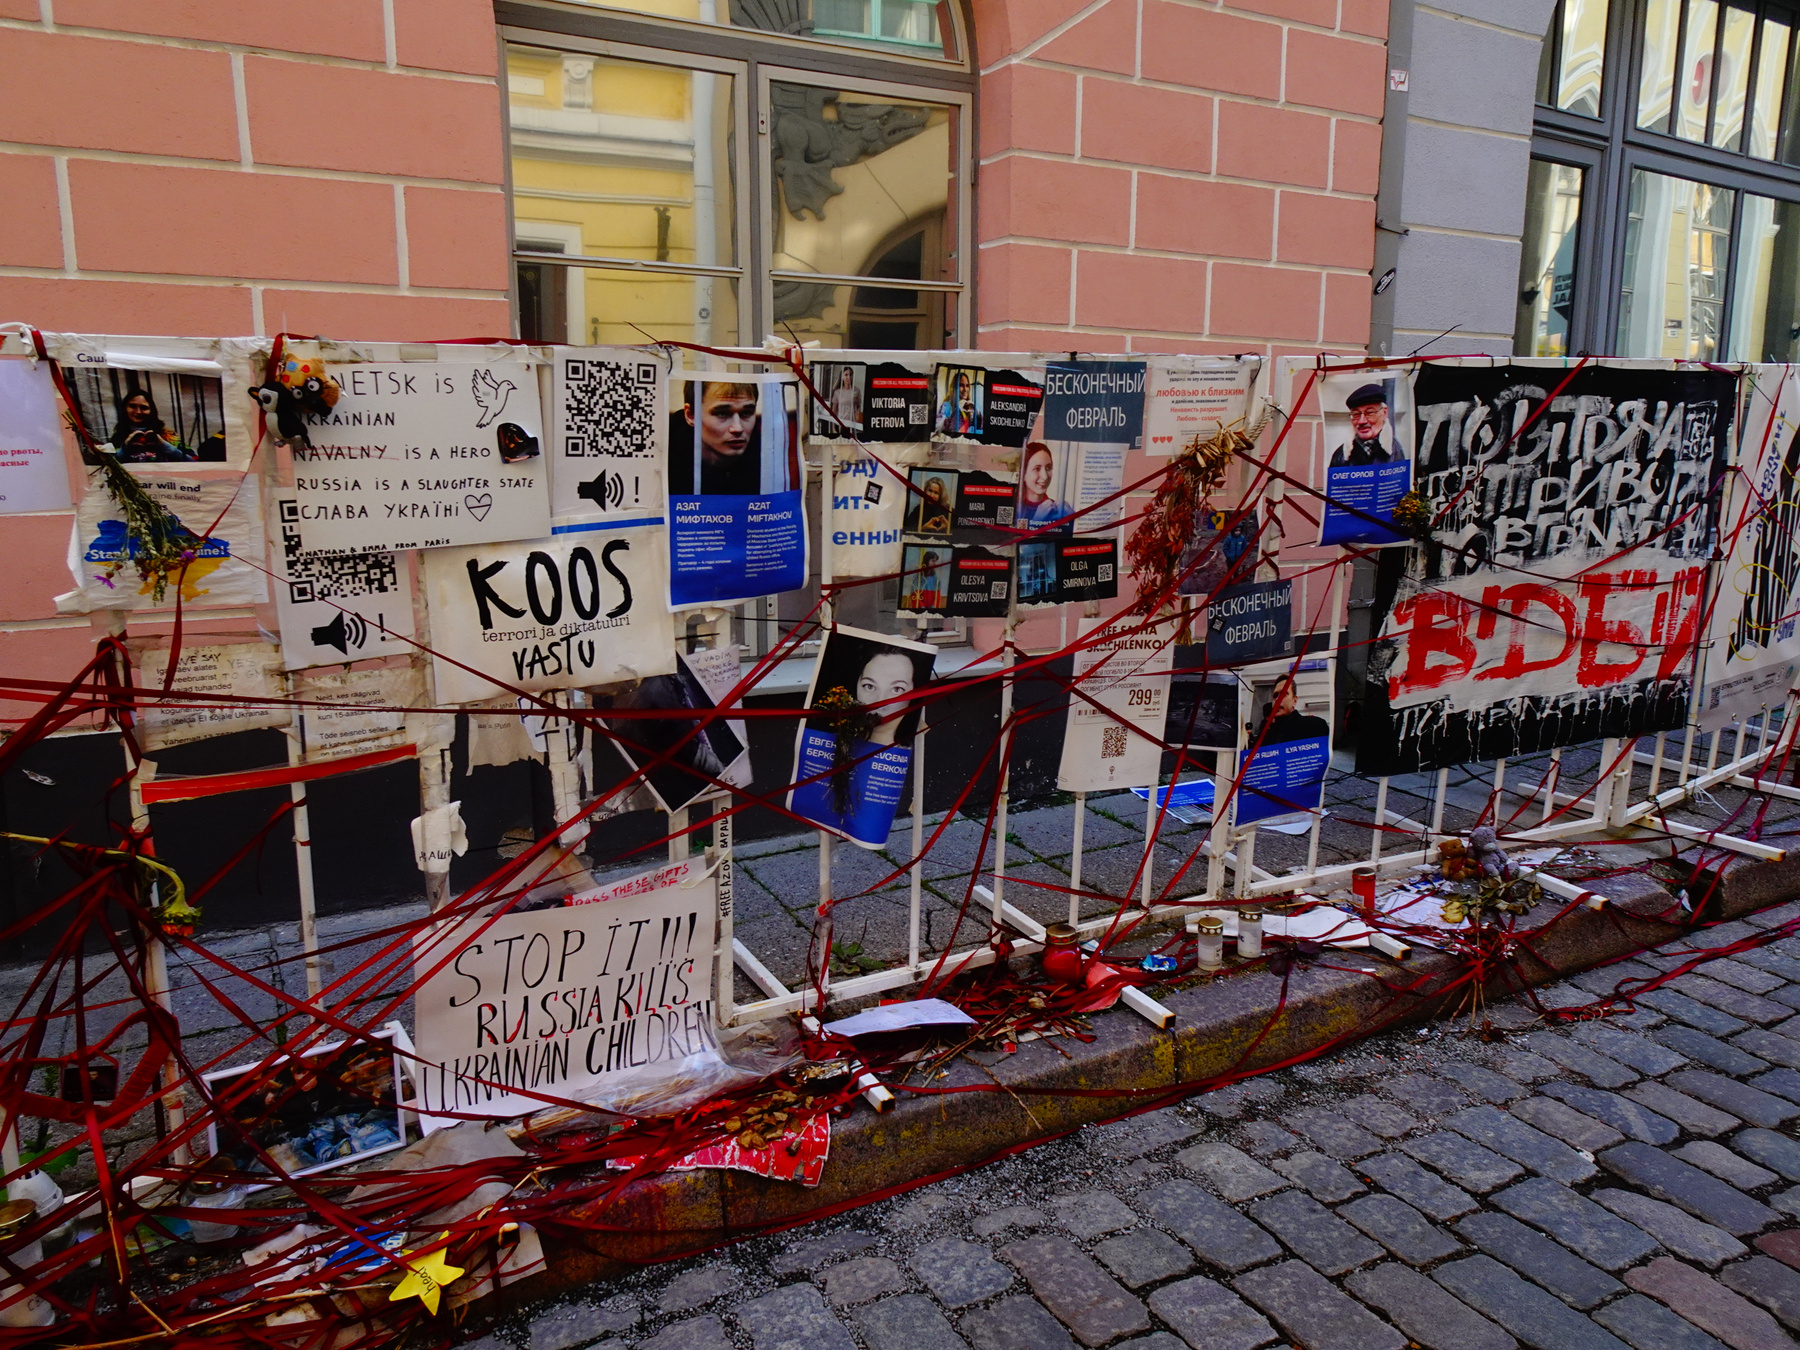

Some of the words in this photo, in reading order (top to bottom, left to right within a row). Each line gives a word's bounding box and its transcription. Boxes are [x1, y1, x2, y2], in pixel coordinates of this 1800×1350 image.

[77, 353, 107, 363] Саш
[331, 371, 417, 396] NETSK
[1046, 368, 1146, 395] БЕСКОНЕЧНЫЙ
[1156, 387, 1199, 397] любовью
[1208, 387, 1244, 396] близким
[871, 397, 906, 409] VIKTORIA
[990, 400, 1027, 412] ALEKSANDRA
[870, 417, 905, 428] PETROVA
[989, 416, 1026, 428] SKOCHILENKO
[1066, 406, 1126, 429] ФЕВРАЛЬ
[10, 448, 43, 457] рвоты,
[430, 447, 440, 460] A
[450, 446, 491, 459] HERO
[1332, 472, 1349, 480] ОЛЕГ
[1350, 470, 1374, 478] ОРЛОВ
[157, 482, 176, 490] will
[180, 484, 201, 492] end
[401, 479, 409, 491] A
[418, 477, 490, 491] SLAUGHTER
[499, 477, 534, 489] STATE
[301, 503, 368, 521] СЛАВА
[675, 502, 701, 511] АЗАТ
[747, 502, 771, 511] AZAT
[968, 502, 985, 511] MARIA
[676, 515, 733, 524] МИФТАХОВ
[747, 511, 793, 523] MIFTAKHOV
[362, 544, 387, 552] EMMA
[395, 541, 417, 549] FROM
[1070, 560, 1089, 571] OLGA
[466, 539, 633, 631] KOOS
[960, 575, 985, 585] OLESYA
[1062, 576, 1097, 589] SMIRNOVA
[953, 592, 989, 602] KRIVTSOVA
[1208, 584, 1292, 619] БЕСКОНЕЧНЫЙ
[482, 627, 537, 643] terrori
[539, 625, 556, 641] ja
[559, 614, 631, 636] diktatuuri
[1225, 619, 1277, 645] ФЕВРАЛЬ
[201, 653, 222, 663] SAY
[513, 632, 596, 681] VASTU
[193, 664, 218, 672] alates
[194, 683, 232, 692] tuhanded
[1128, 688, 1152, 706] 299
[235, 709, 269, 719] Ukrainas
[340, 729, 367, 738] seisneb
[1298, 743, 1320, 751] YASHIN
[1261, 750, 1279, 759] ЯШИН
[612, 876, 650, 898] THESE
[449, 929, 585, 1008] STOP
[477, 985, 603, 1048] RUSSIA
[585, 1000, 718, 1076] CHILDREN
